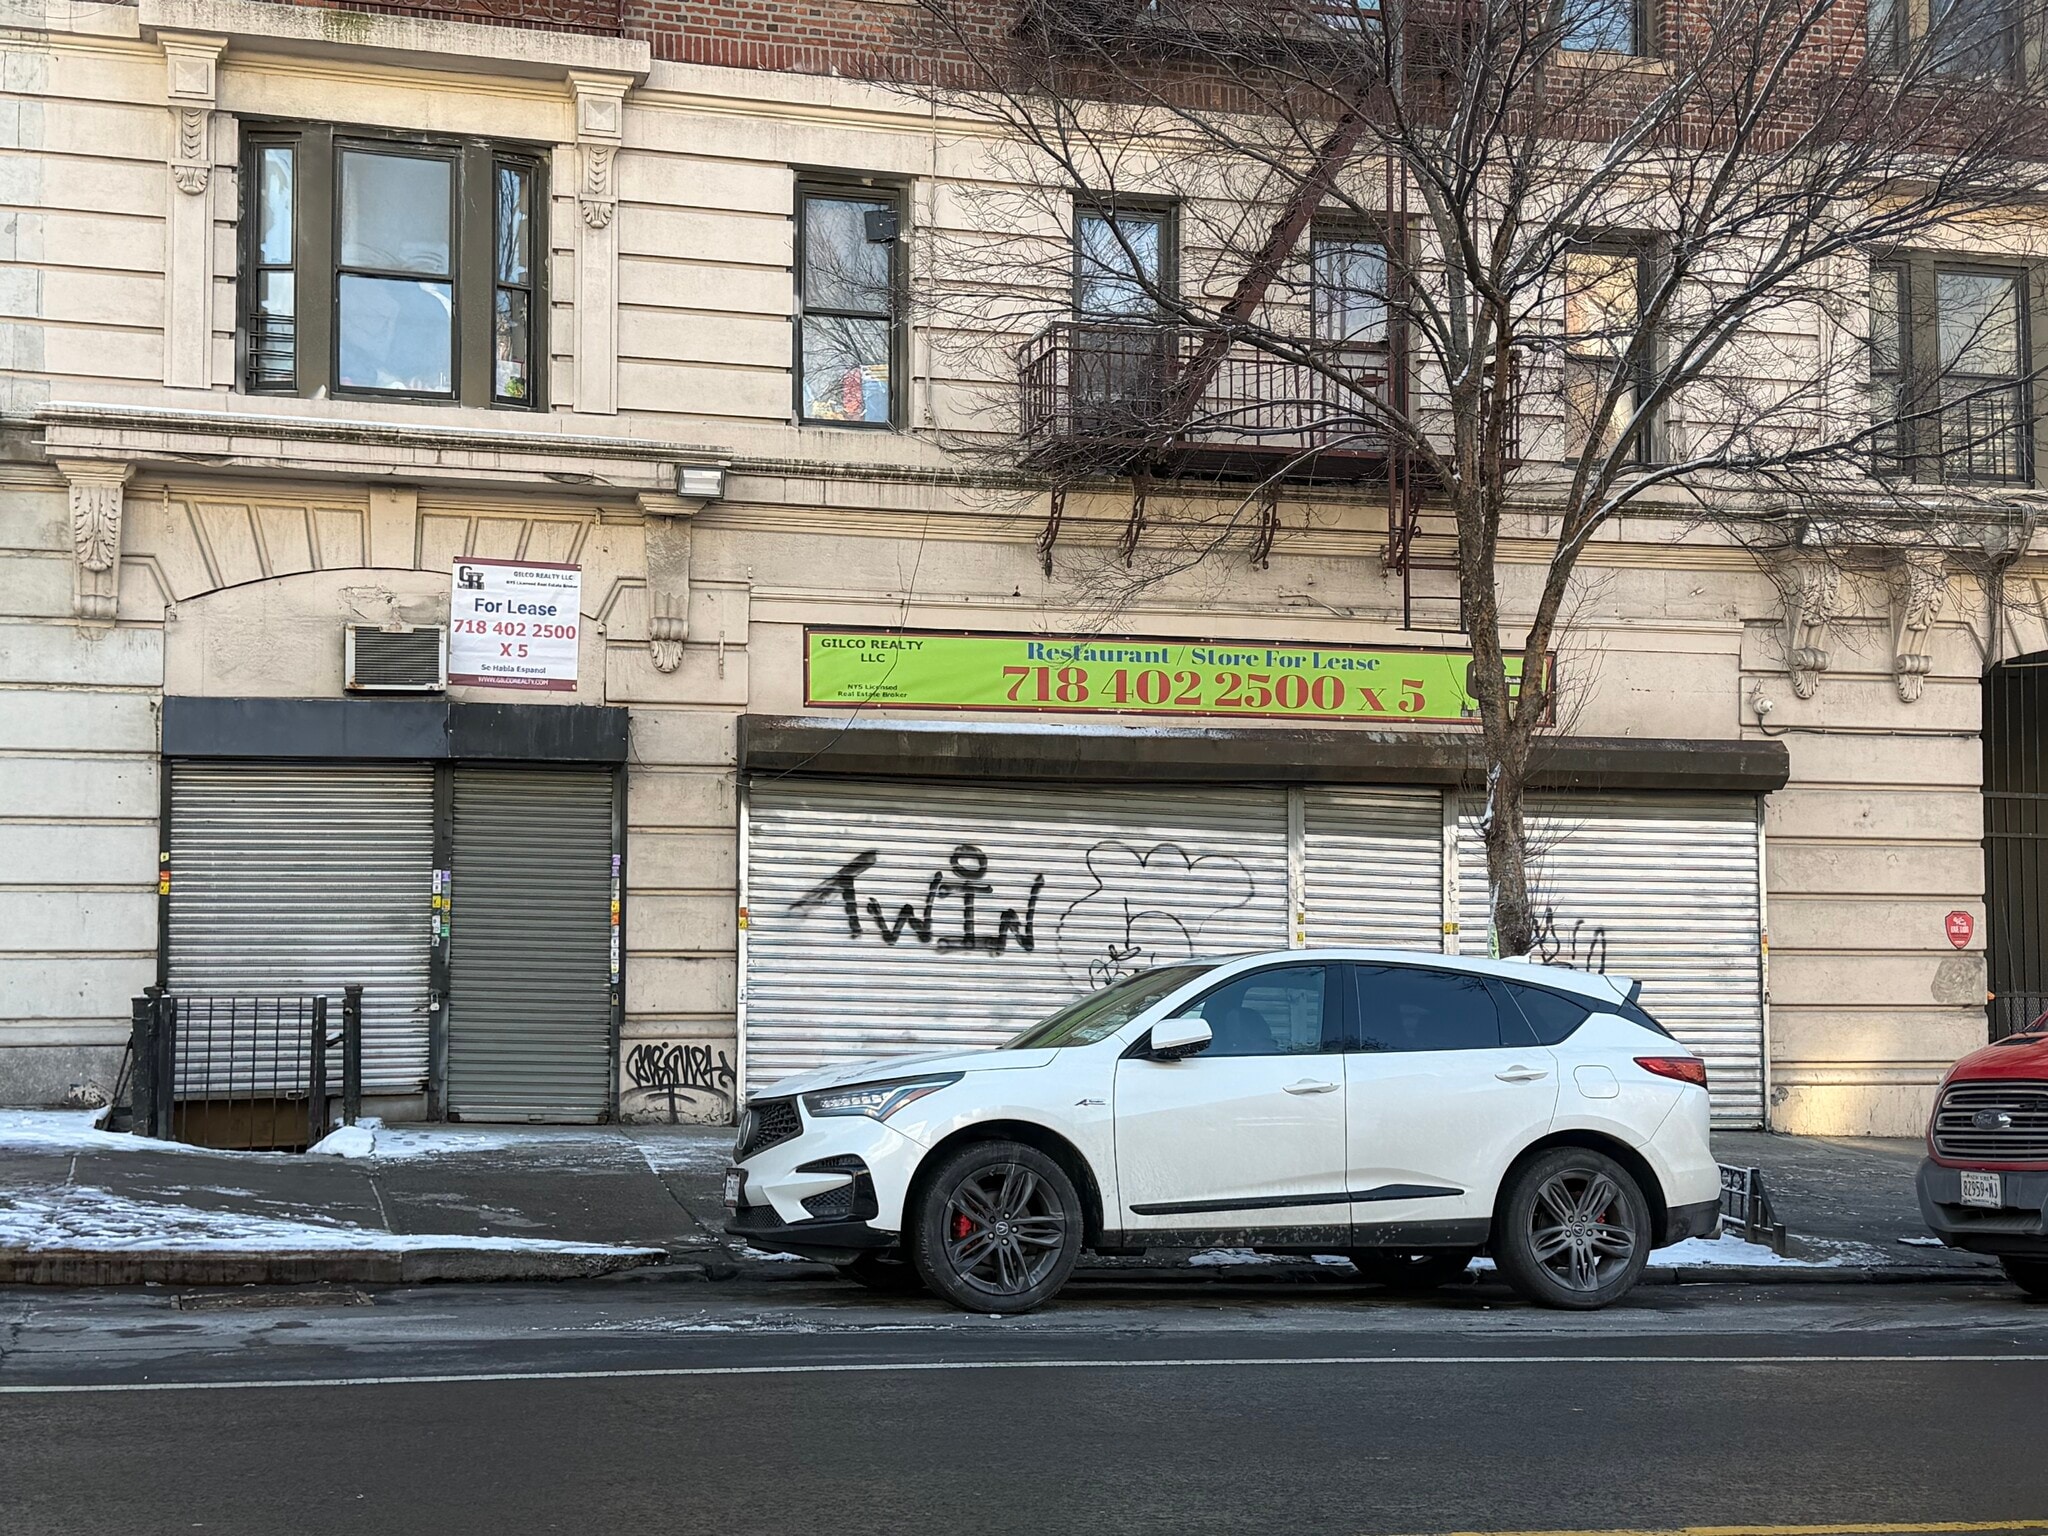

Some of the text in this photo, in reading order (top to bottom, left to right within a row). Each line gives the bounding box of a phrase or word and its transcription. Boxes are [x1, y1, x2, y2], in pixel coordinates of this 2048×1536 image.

[536, 572, 560, 580] REALTY
[474, 597, 557, 616] For Lease
[453, 619, 576, 639] 718 402 2500
[500, 643, 528, 658] X 5
[821, 638, 924, 650] GILCO REALTY
[860, 653, 886, 663] LLC
[1028, 641, 1170, 665] Restaurant
[1191, 647, 1260, 667] Store
[1265, 650, 1307, 668] For
[1312, 652, 1381, 671] Lease
[493, 664, 515, 673] Habla
[516, 665, 546, 674] Espanol
[1002, 666, 1089, 703] 718
[1100, 669, 1203, 706] 402
[1214, 671, 1346, 710] 2500
[1398, 678, 1426, 713] 5
